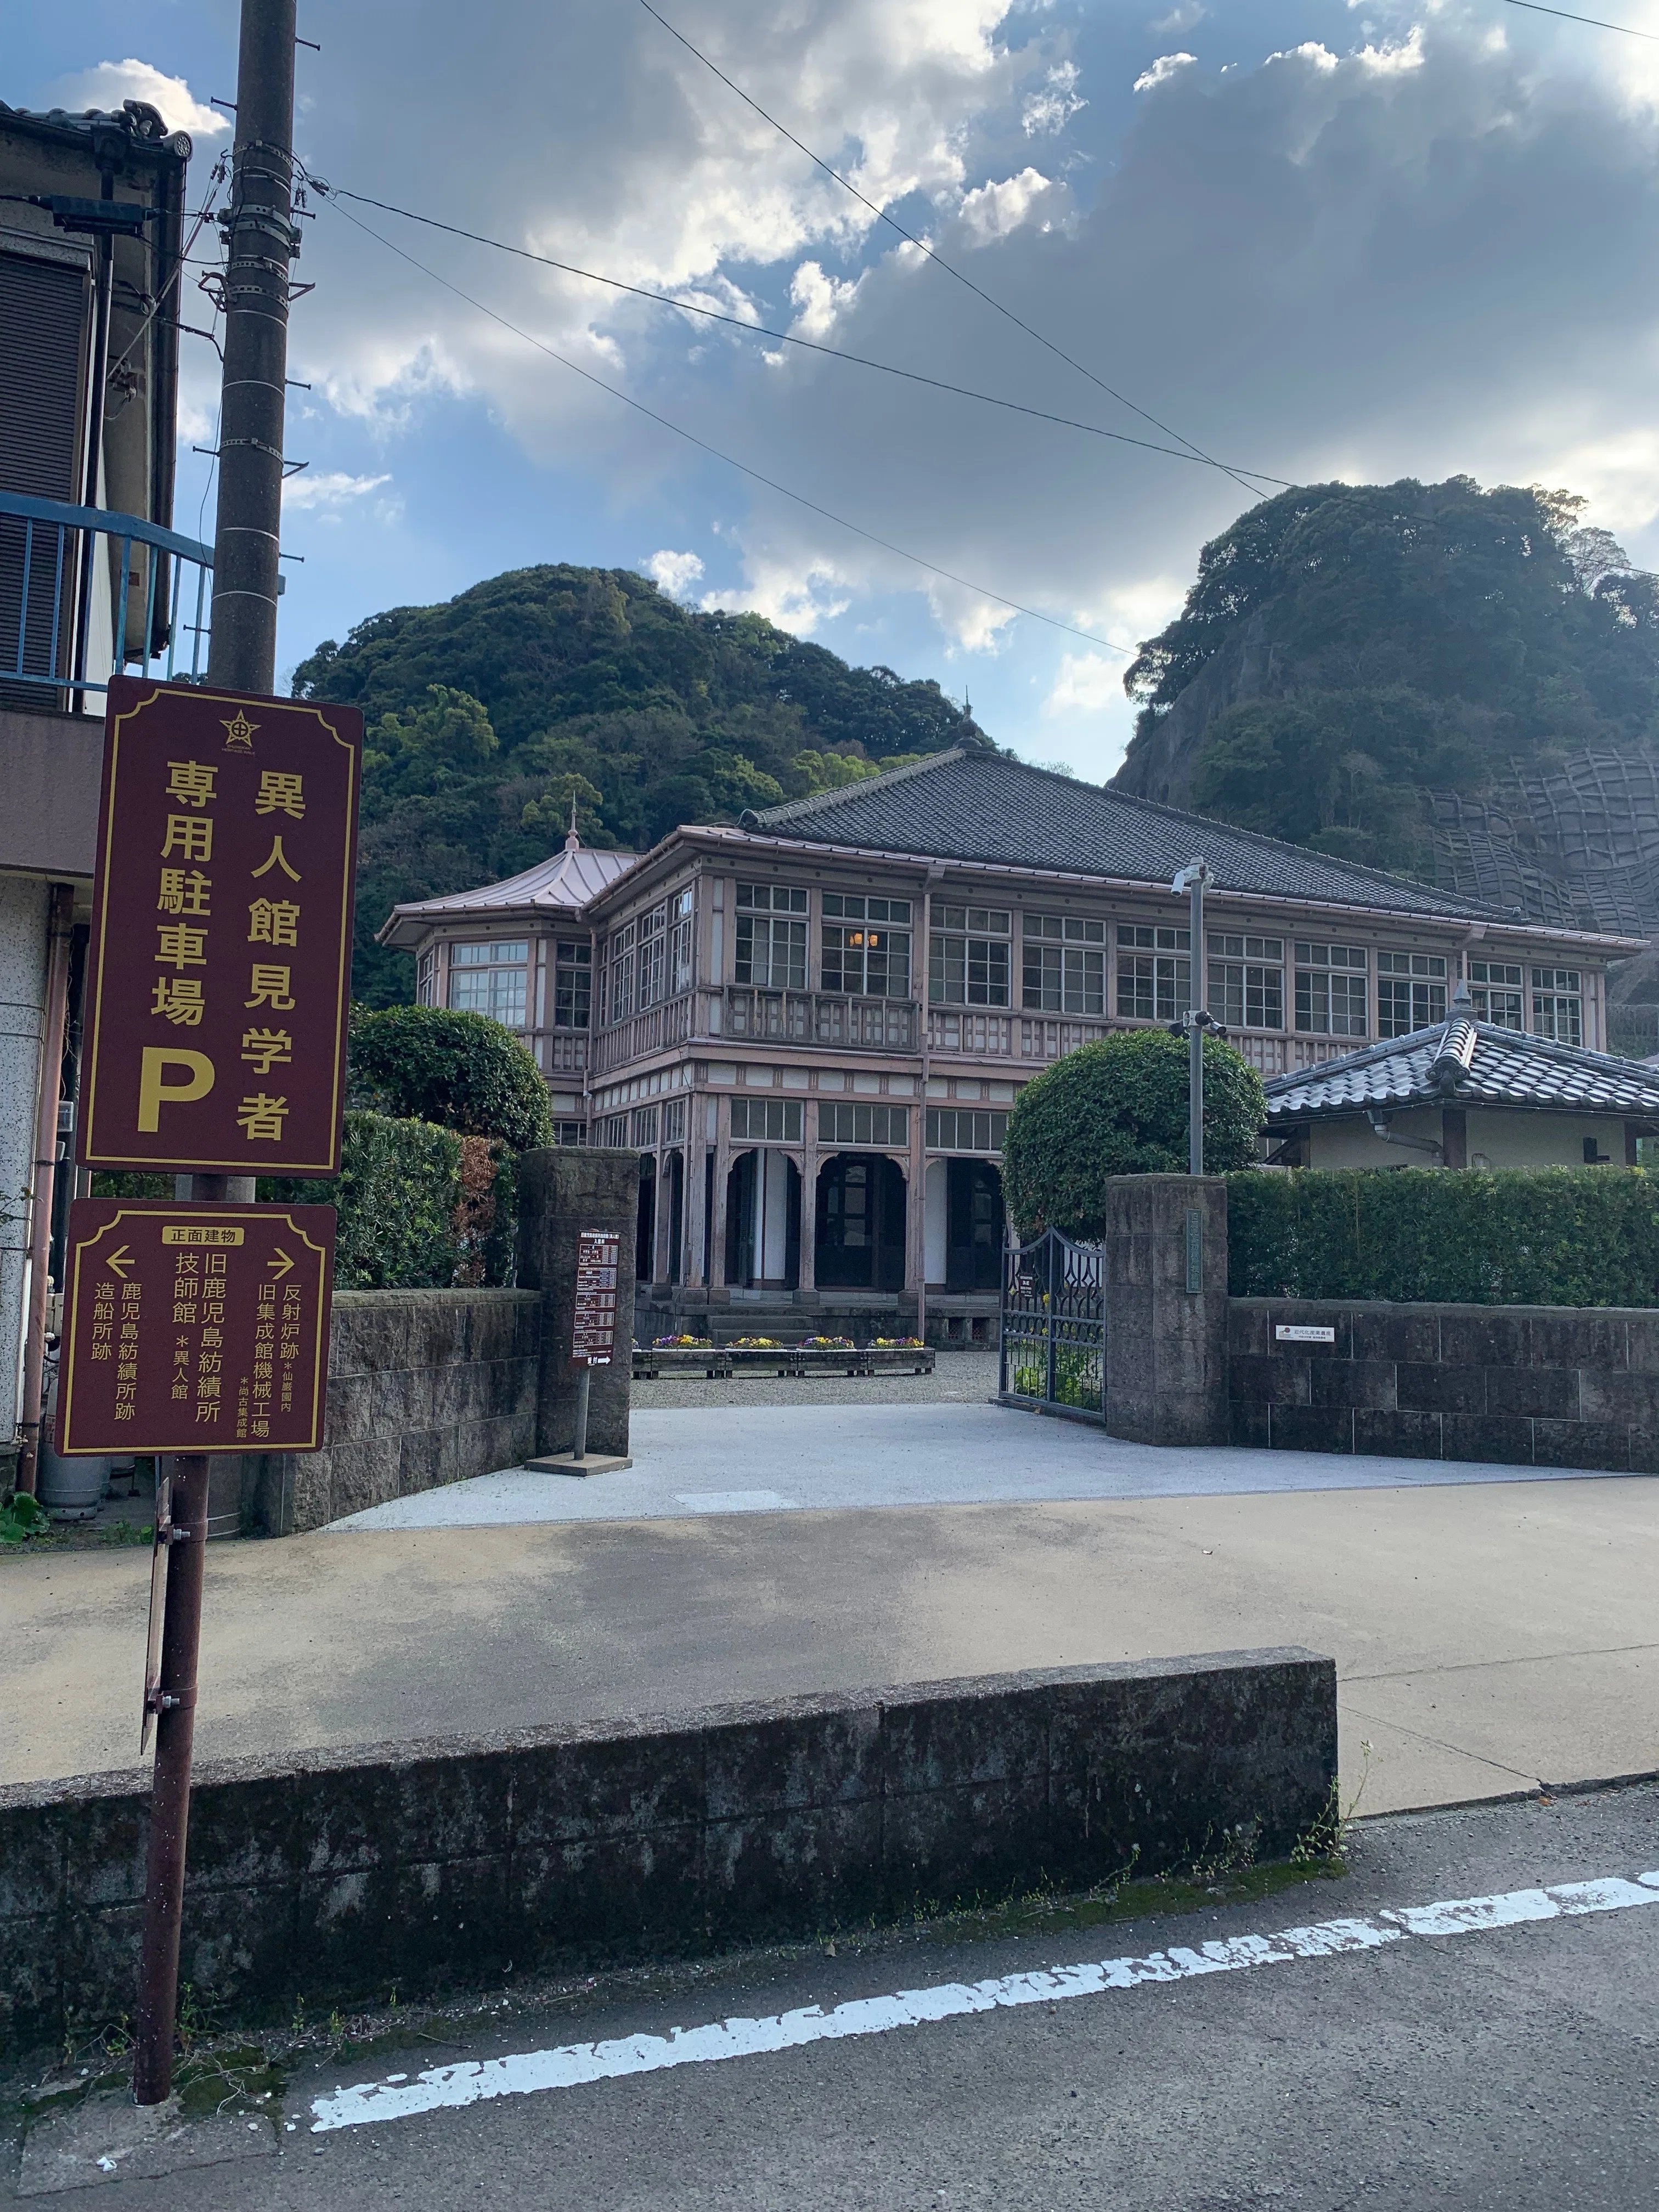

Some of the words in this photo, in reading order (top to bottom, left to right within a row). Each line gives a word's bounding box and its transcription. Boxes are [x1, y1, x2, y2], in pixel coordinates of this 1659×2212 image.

[150, 760, 218, 1026] 専用駐車場
[237, 770, 306, 1141] 異人館見学者
[137, 1046, 215, 1132] P
[171, 1229, 236, 1243] 正面建物
[172, 1252, 200, 1324] 技師館
[91, 1282, 115, 1361] 造船所跡
[114, 1282, 142, 1420] 鹿児島紡績所跡
[195, 1252, 227, 1423] 旧鹿児島紡績所
[250, 1284, 276, 1438] 旧集成館機械工場
